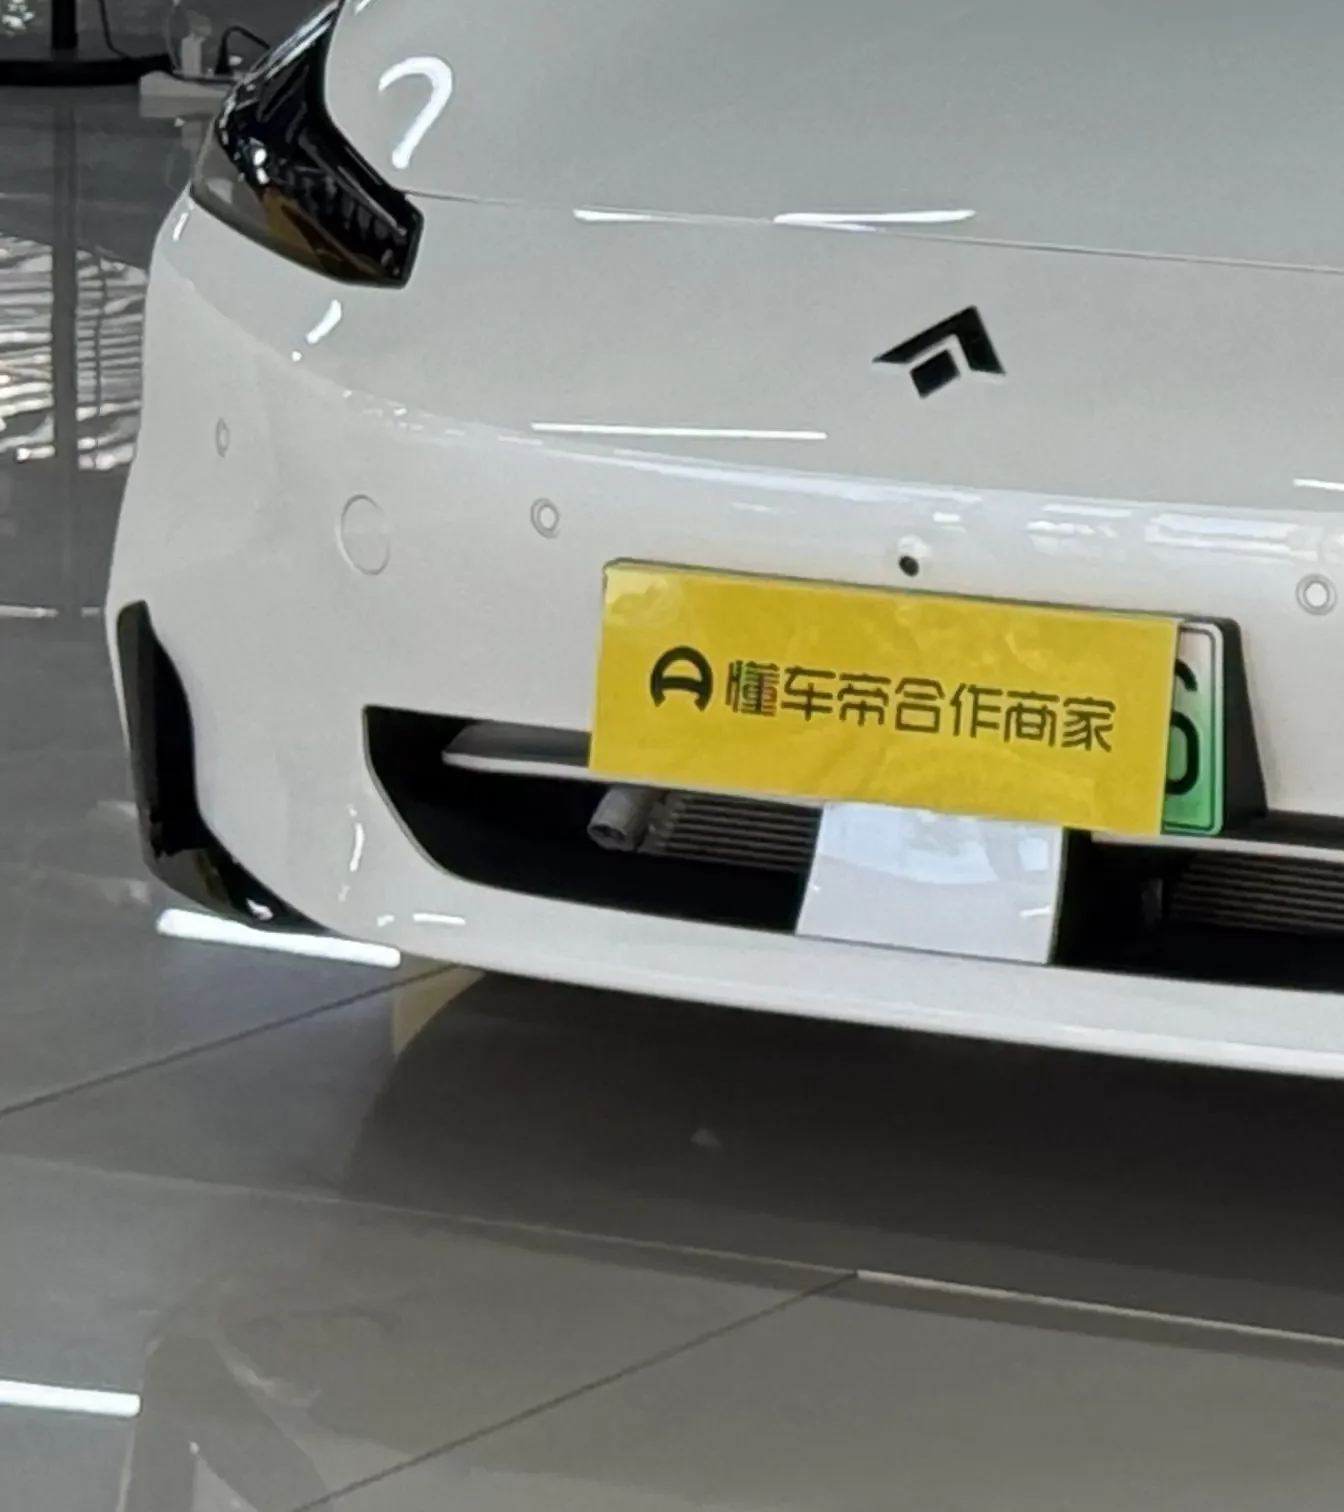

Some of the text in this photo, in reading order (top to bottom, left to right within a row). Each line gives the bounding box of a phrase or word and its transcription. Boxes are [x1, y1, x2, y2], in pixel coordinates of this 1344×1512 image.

[725, 659, 1117, 753] 懂车帝合作商家
